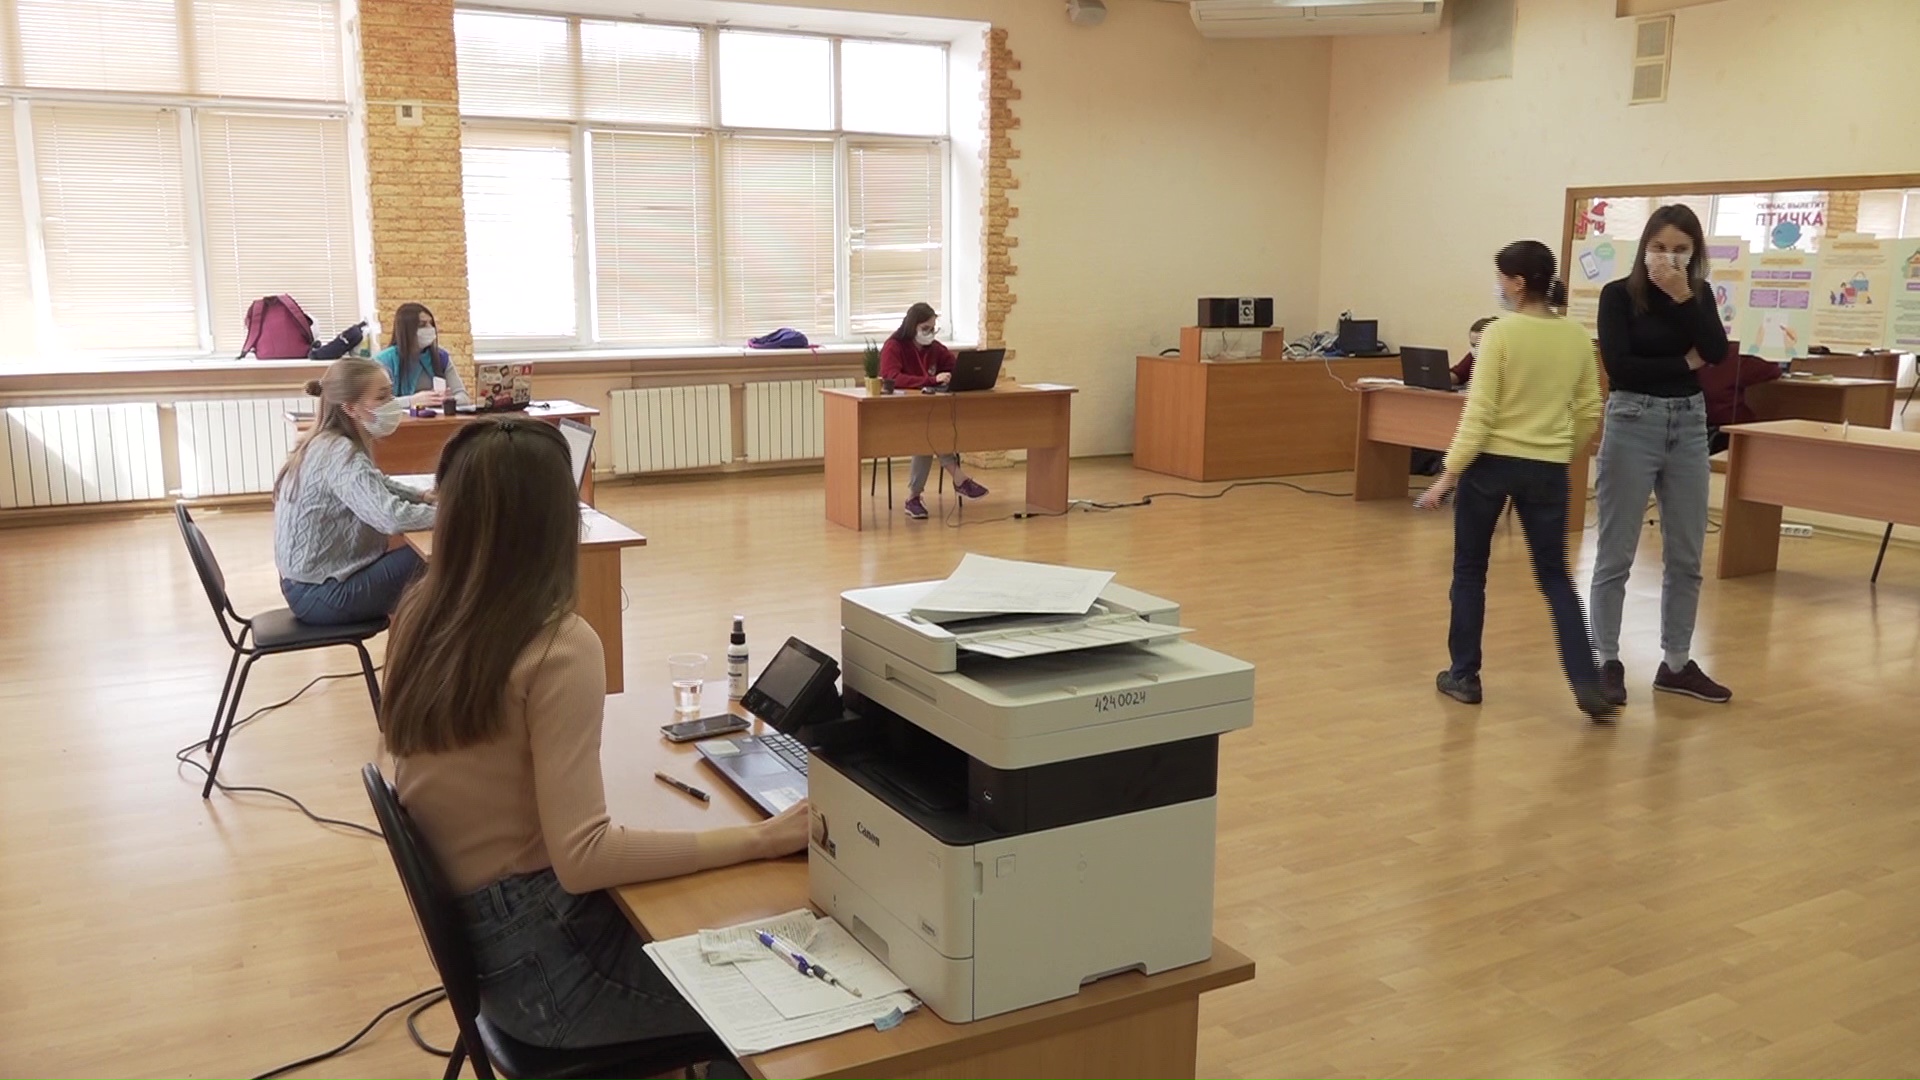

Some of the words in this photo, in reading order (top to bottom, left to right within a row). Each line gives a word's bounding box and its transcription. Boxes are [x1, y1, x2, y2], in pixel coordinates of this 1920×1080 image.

[1787, 201, 1826, 209] ВЫЛЕТИТ
[1755, 211, 1824, 226] ПТИЧКА
[1095, 691, 1146, 713] 4240024
[857, 821, 880, 848] Canon
